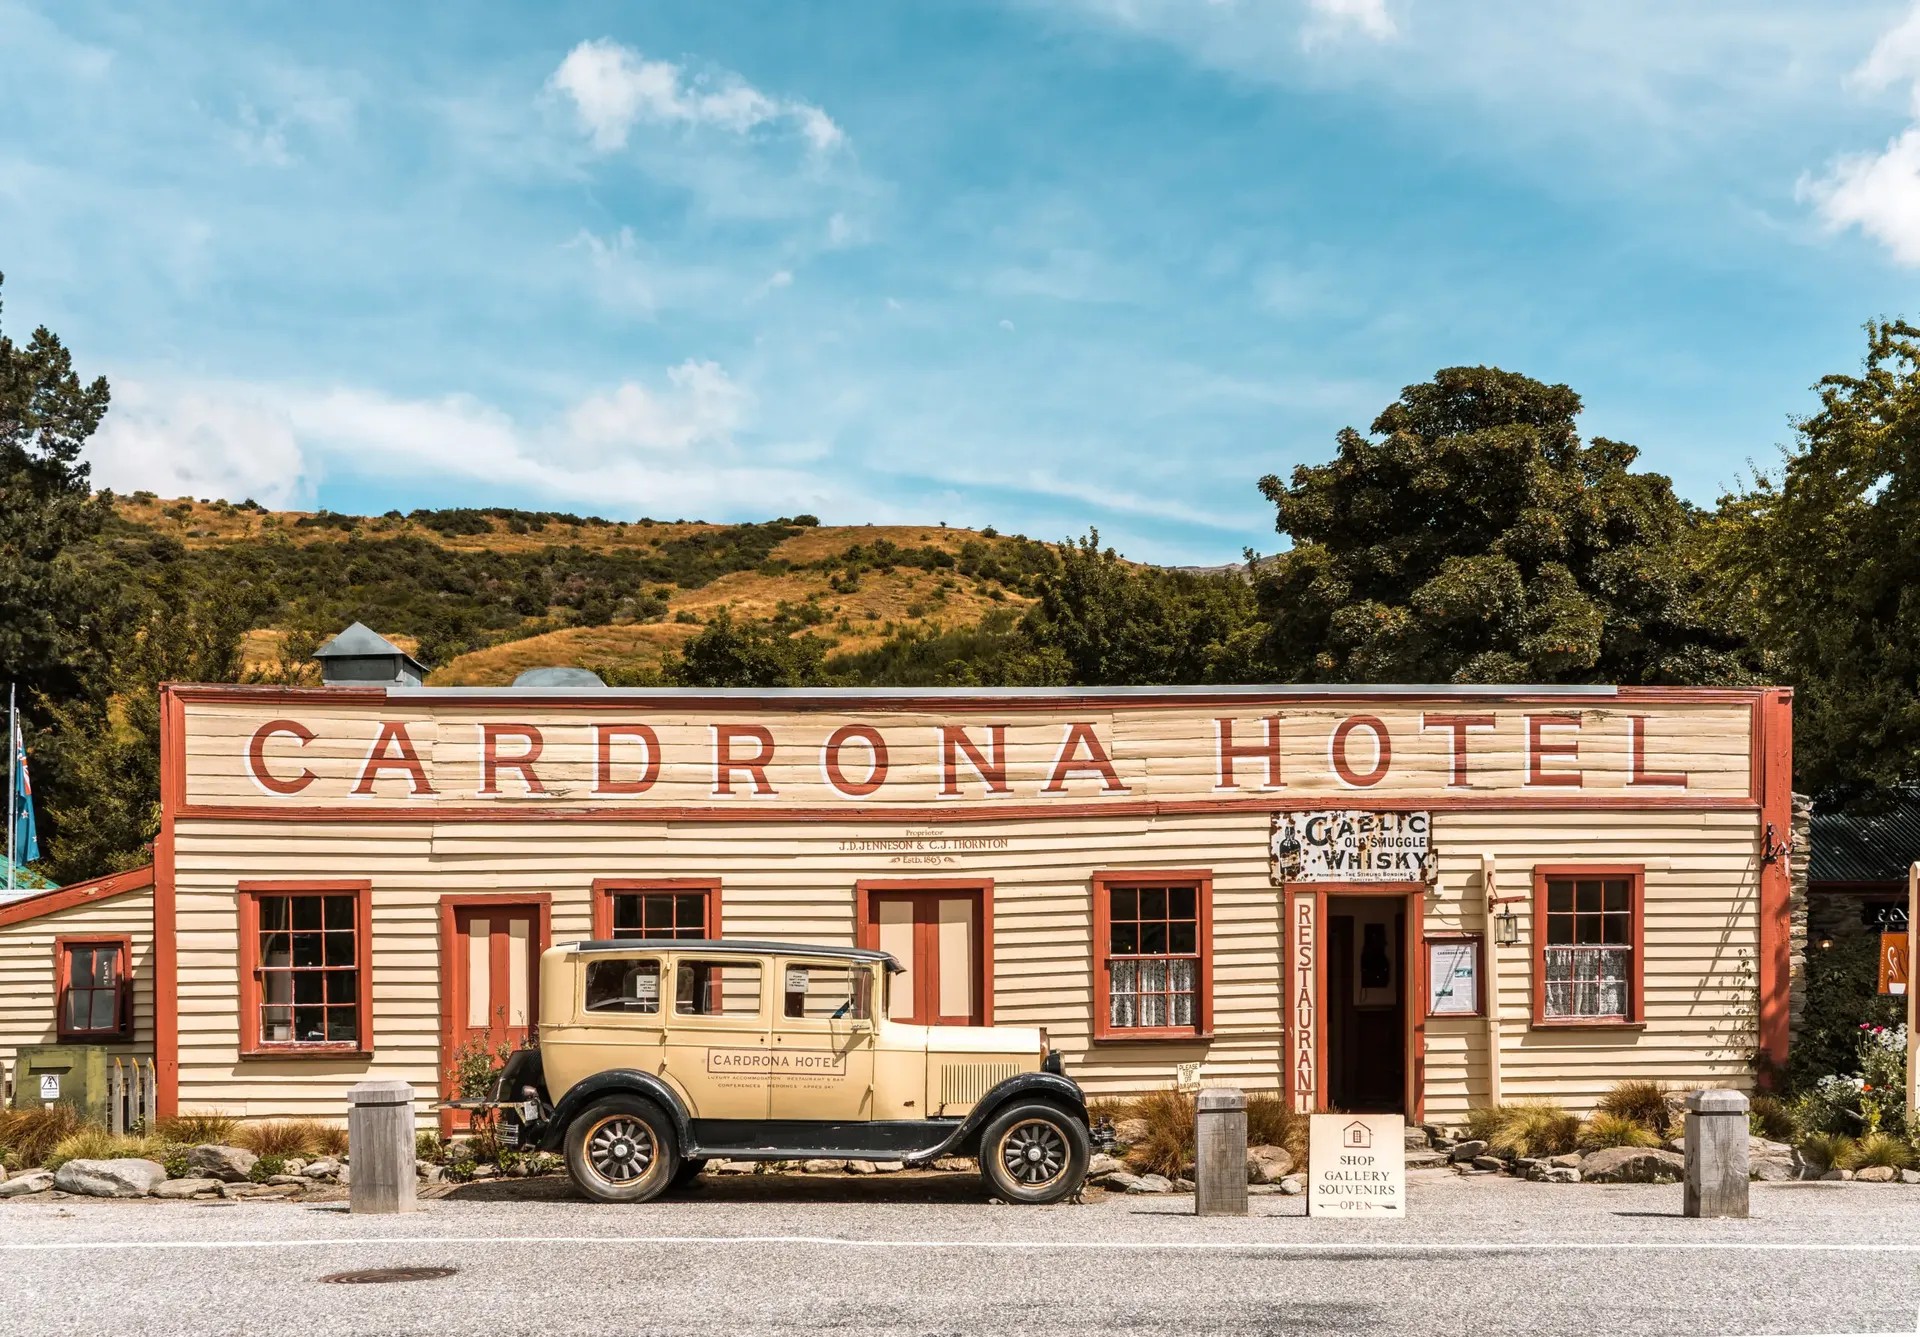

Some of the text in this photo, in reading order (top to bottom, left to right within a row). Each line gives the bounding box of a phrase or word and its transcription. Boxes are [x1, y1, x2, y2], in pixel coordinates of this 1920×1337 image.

[245, 711, 1688, 799] CARDRONA HOTEL
[905, 829, 944, 837] Proprietor
[1305, 815, 1427, 847] GAELIC
[916, 841, 924, 850] &
[1322, 850, 1429, 870] WHISKY
[1297, 904, 1313, 1112] RESTAURANT
[713, 1055, 839, 1068] CARDRONA HOTEL
[1340, 1155, 1375, 1166] SHOP
[1324, 1170, 1390, 1181] GALLERY
[1318, 1184, 1396, 1196] SOUVENIRS
[1339, 1200, 1372, 1210] OPEN
